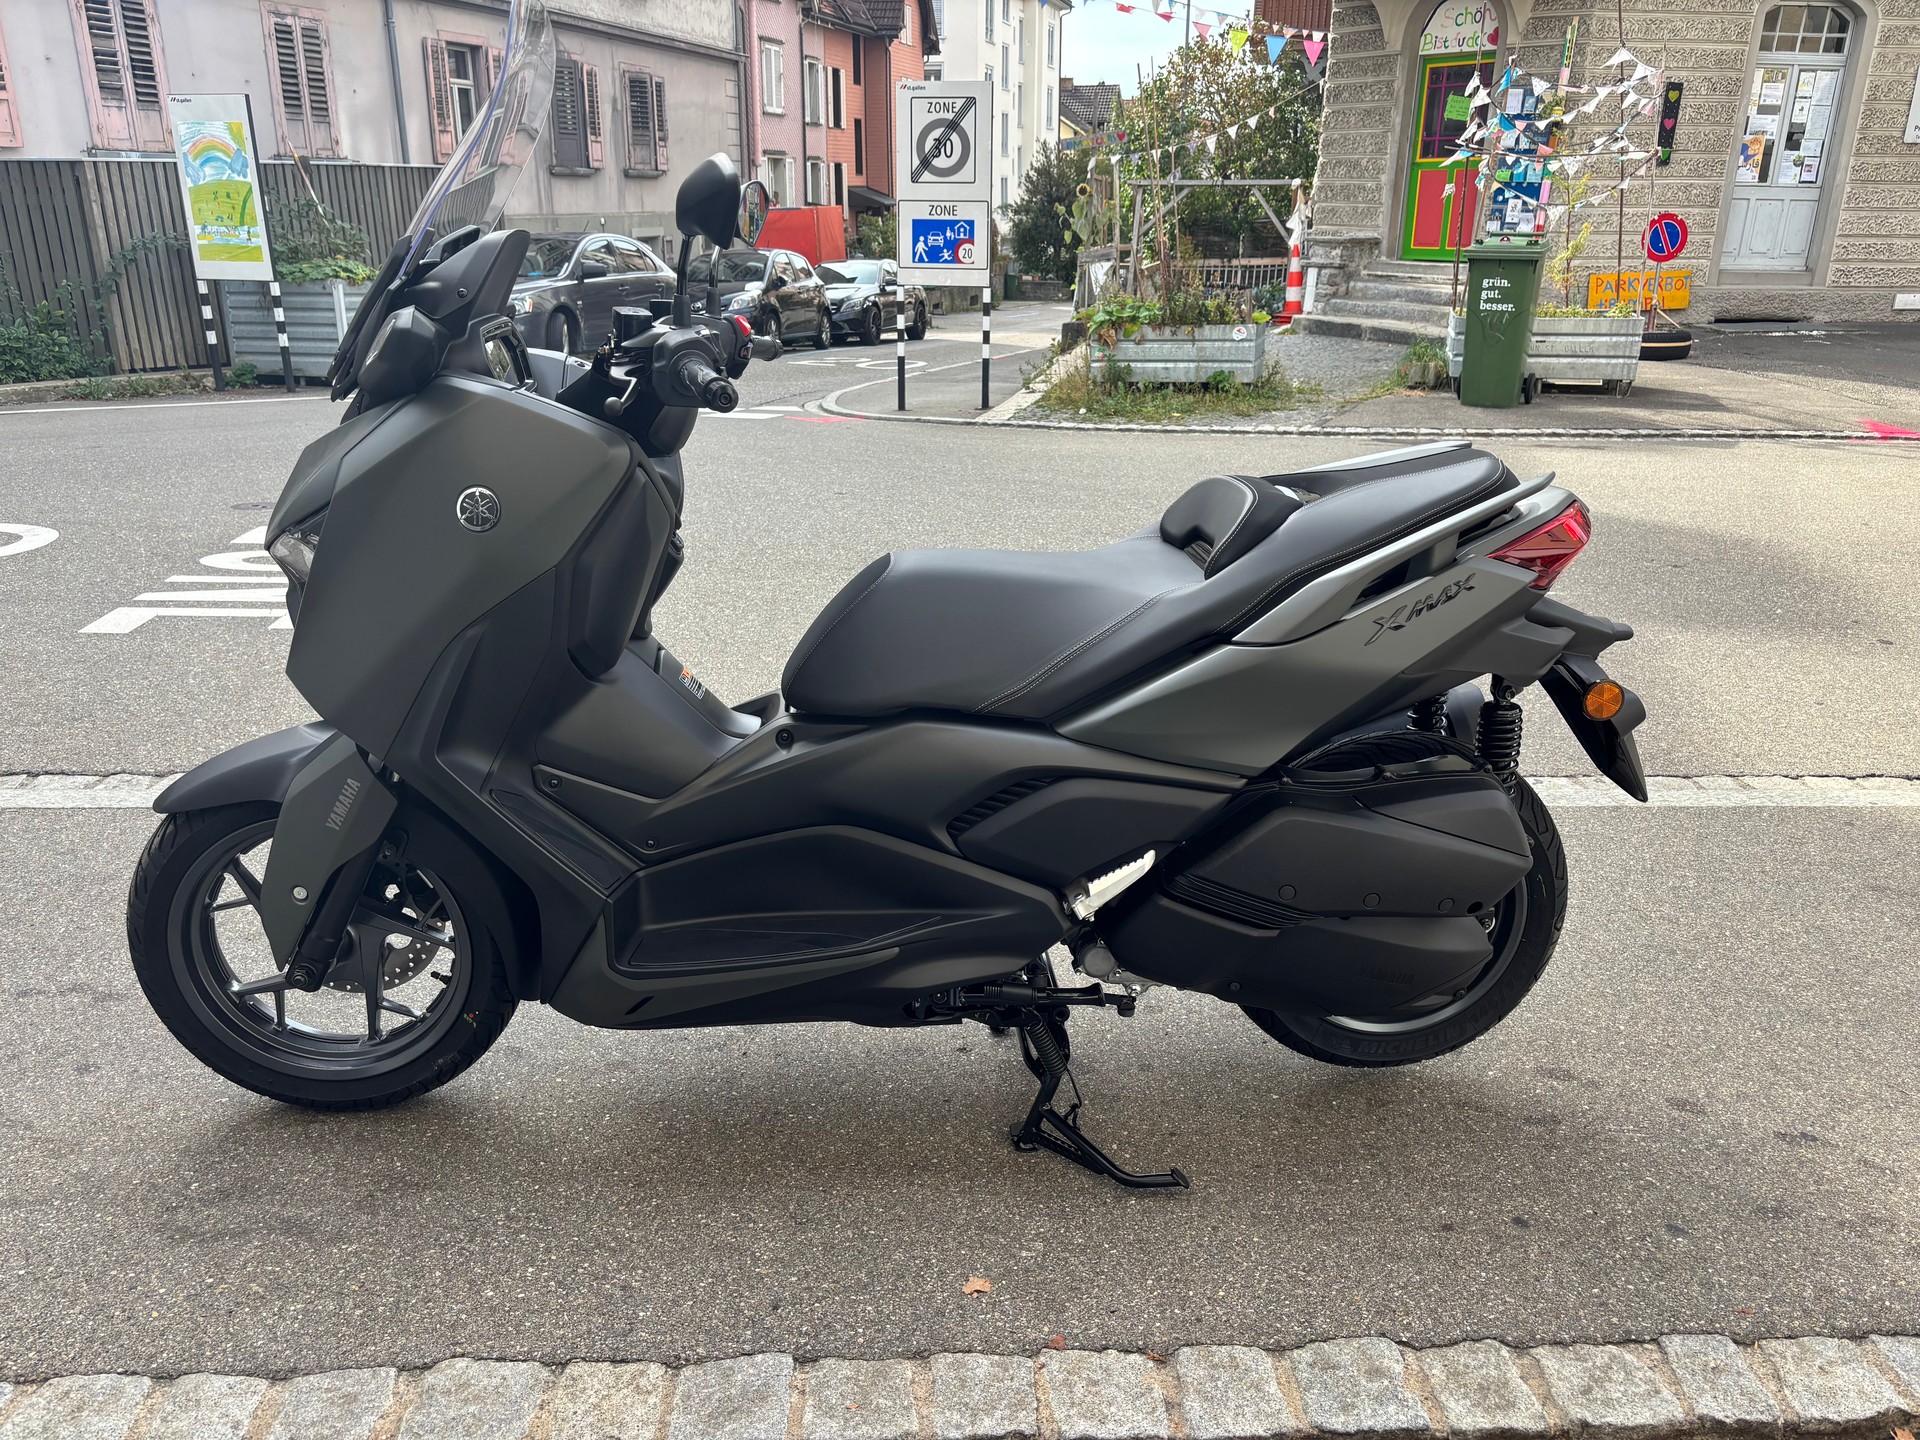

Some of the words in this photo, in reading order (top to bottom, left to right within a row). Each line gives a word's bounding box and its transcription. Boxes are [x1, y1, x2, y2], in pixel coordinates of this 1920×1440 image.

[927, 101, 957, 113] ZONE
[932, 138, 954, 158] 30
[928, 204, 958, 216] ZONE
[962, 247, 973, 260] 20
[1482, 276, 1511, 288] grün.
[1480, 289, 1502, 300] gut.
[1479, 299, 1515, 312] besser.
[325, 777, 361, 831] YAMAHA
